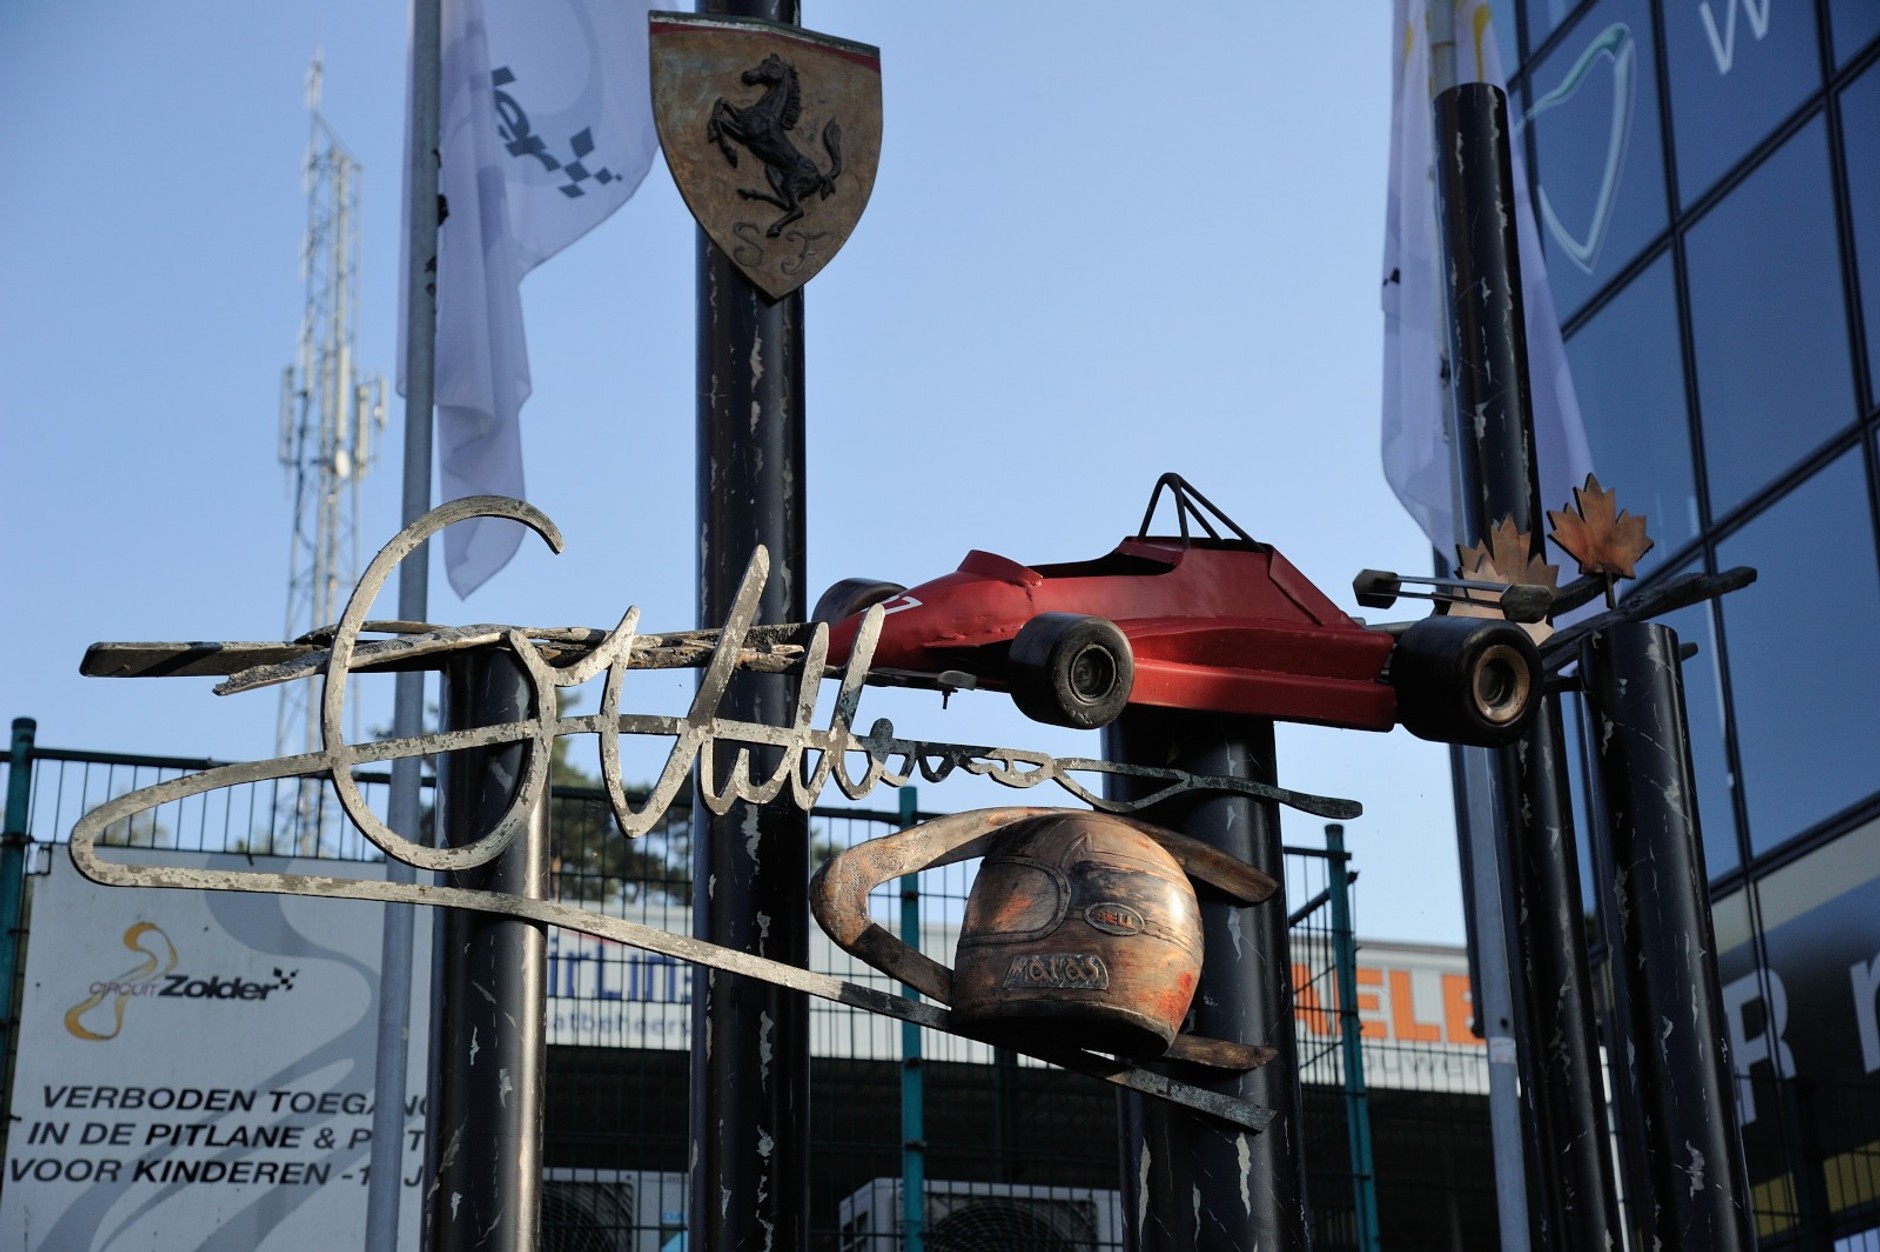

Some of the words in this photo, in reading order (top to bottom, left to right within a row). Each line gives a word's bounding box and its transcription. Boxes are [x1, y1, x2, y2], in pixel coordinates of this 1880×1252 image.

[1095, 911, 1135, 930] BELL
[158, 975, 275, 1001] Zolder
[43, 1085, 257, 1112] VERBODEN
[27, 1122, 70, 1145] IN
[79, 1123, 136, 1146] DE
[144, 1123, 305, 1148] PITLANE
[313, 1127, 336, 1150] &
[10, 1158, 122, 1182] VOOR
[132, 1159, 331, 1185] KINDEREN
